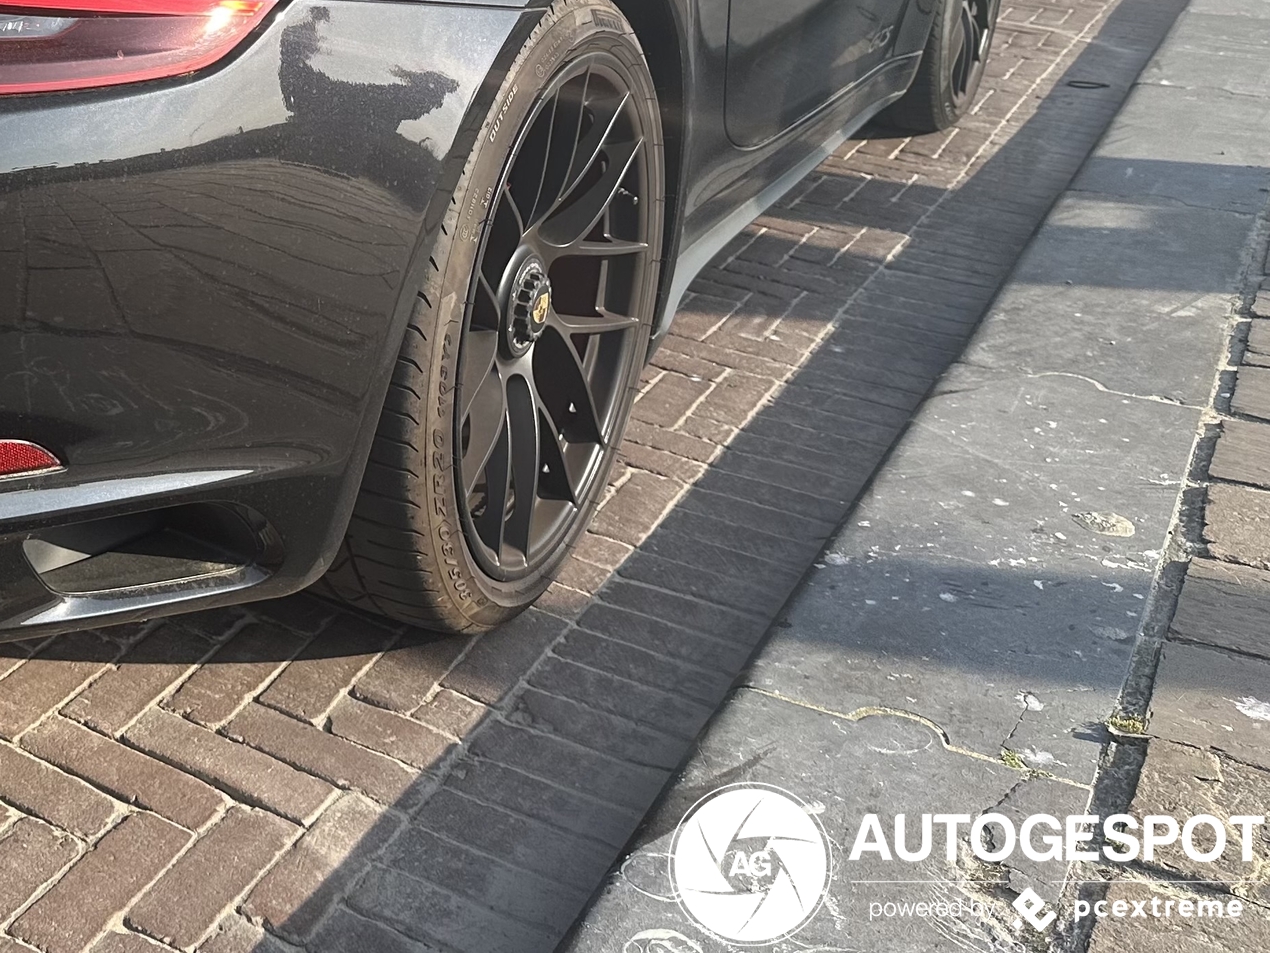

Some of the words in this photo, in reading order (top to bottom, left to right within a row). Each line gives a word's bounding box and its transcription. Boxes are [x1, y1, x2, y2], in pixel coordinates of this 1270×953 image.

[489, 83, 519, 143] OUTSIDE
[432, 428, 447, 517] ZR20
[438, 525, 473, 601] 305/30
